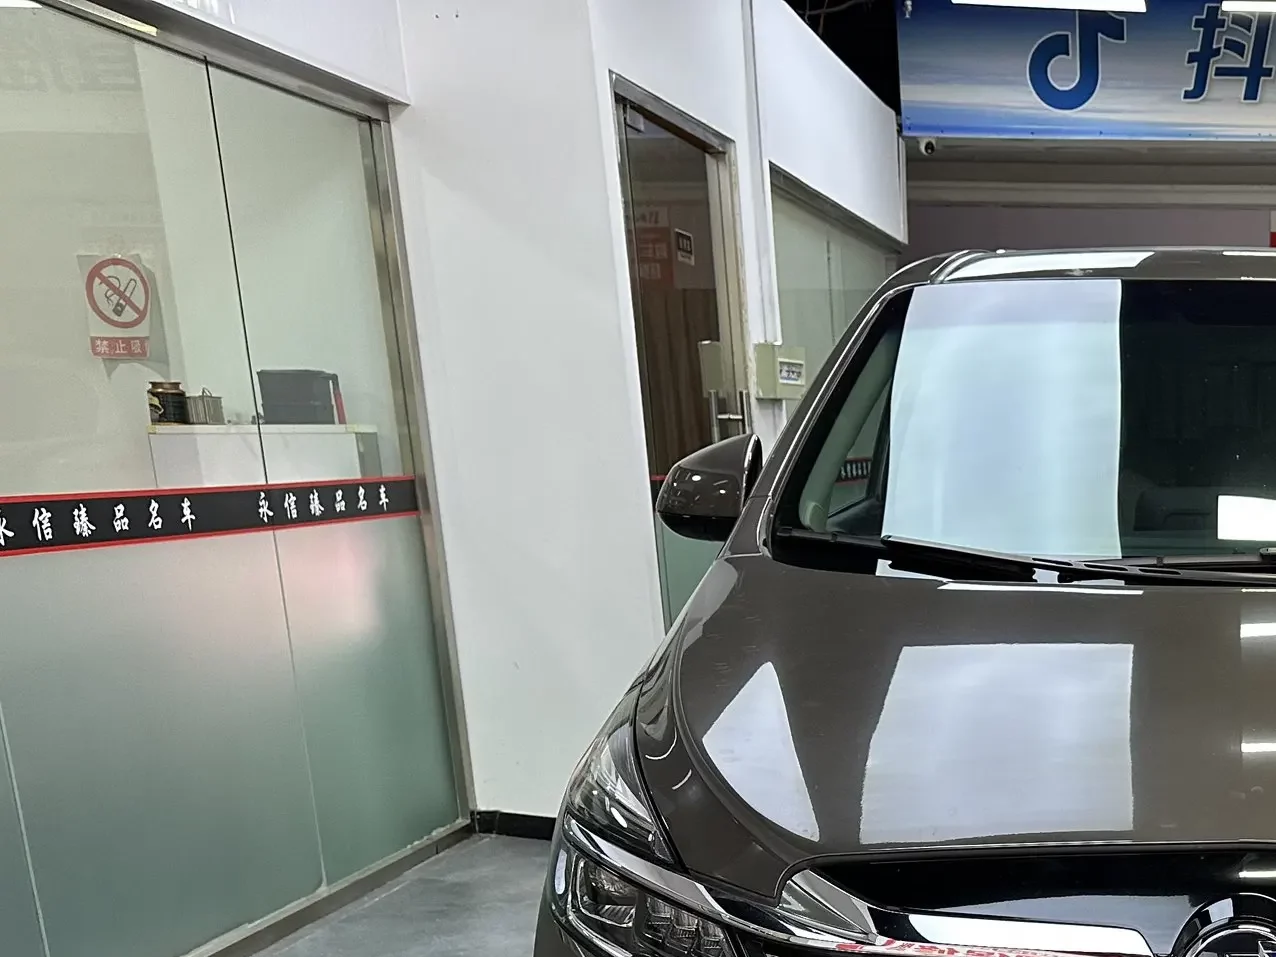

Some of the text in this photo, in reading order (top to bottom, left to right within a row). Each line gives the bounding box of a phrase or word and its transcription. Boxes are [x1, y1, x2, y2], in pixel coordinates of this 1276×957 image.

[95, 338, 149, 354] 禁止吸
[258, 484, 390, 523] 永信臻品名车
